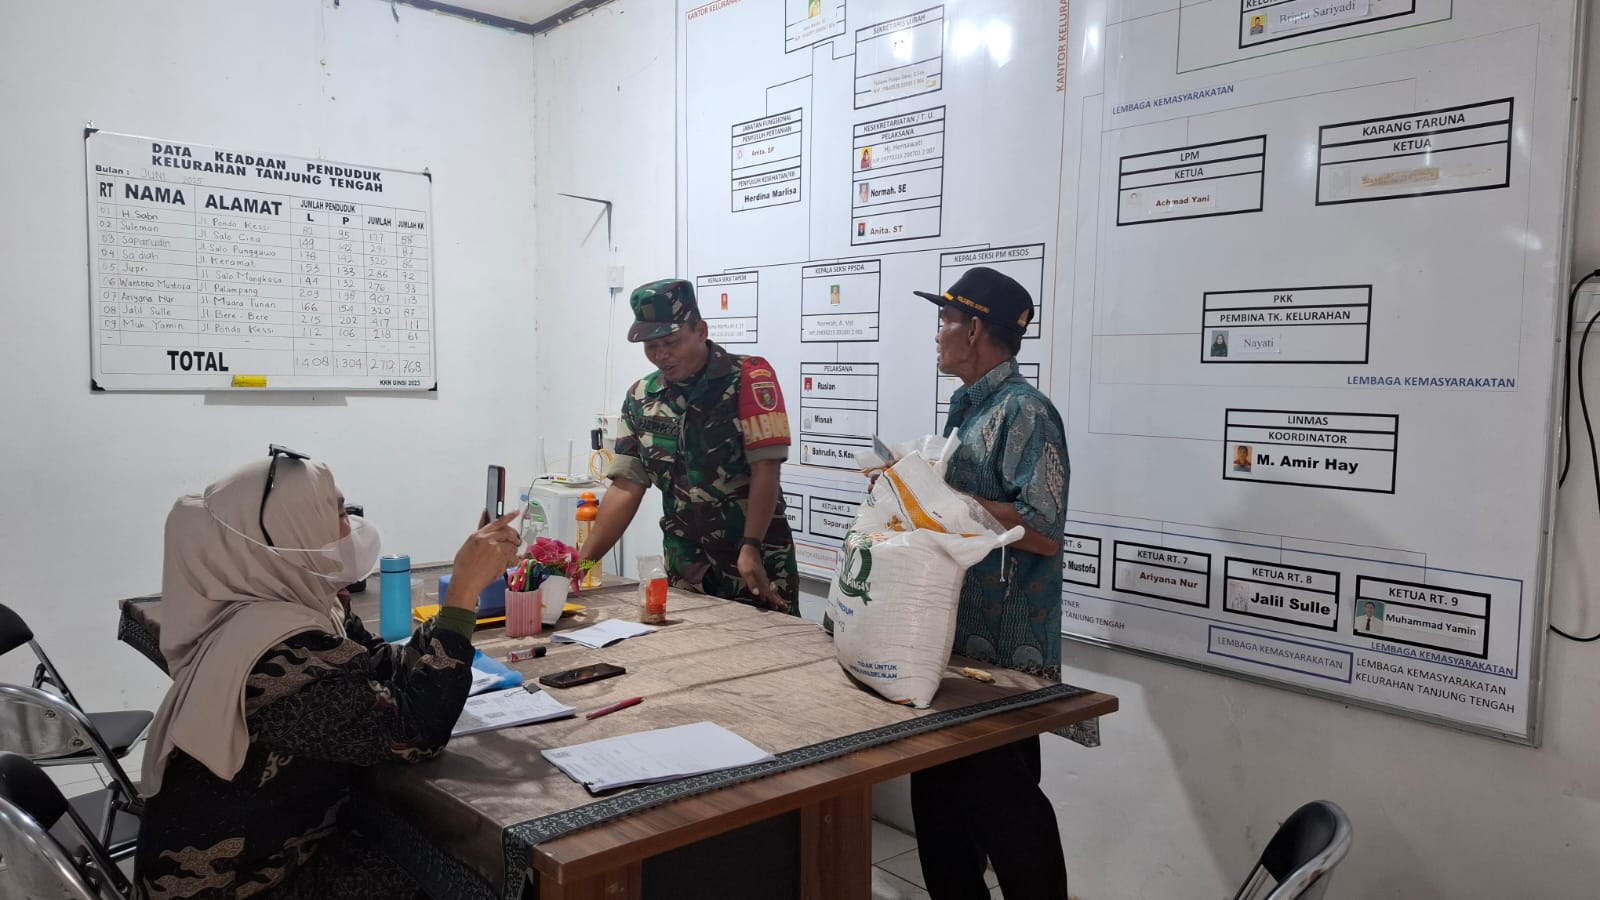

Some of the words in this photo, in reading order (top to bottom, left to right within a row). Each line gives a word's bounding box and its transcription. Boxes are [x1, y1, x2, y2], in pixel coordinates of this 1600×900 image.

[1056, 43, 1066, 92] KANTOR
[1112, 101, 1151, 115] LEMBAGA
[1153, 84, 1234, 107] KEMASYARAKATAN
[863, 115, 915, 132] KESEKRETARIATAN
[1362, 120, 1411, 137] KARANG
[1414, 113, 1465, 130] TARUNA
[881, 128, 914, 141] PELAKSANA
[1393, 138, 1432, 152] KETUA
[152, 142, 192, 158] DATA
[214, 151, 286, 170] KEADAAN
[306, 163, 381, 182] PENDUDUK
[1180, 150, 1200, 162] LPM
[96, 164, 124, 175] Bulan
[152, 155, 246, 176] KELURAHAN
[256, 168, 322, 185] TANJUNG
[330, 177, 383, 192] TENGAH
[1175, 168, 1204, 179] KETUA
[100, 182, 114, 198] RT
[125, 184, 186, 206] NAMA
[898, 184, 907, 193] SE
[744, 192, 770, 203] Herdina
[772, 188, 797, 198] Marlisa
[1156, 197, 1189, 207] Achmad
[1192, 195, 1210, 204] Yani
[205, 194, 282, 216] ALAMAT
[300, 200, 324, 210] JUMLAH
[325, 202, 356, 213] PENDUDUK
[307, 214, 314, 222] L
[342, 217, 350, 225] P
[368, 216, 392, 227] JUMLAH
[398, 221, 417, 230] JUMLAH
[893, 225, 903, 234] ST
[954, 254, 977, 263] KEPALA
[978, 252, 994, 261] SEKSI
[995, 251, 1007, 259] PM
[1008, 248, 1029, 258] KESOS
[337, 267, 356, 277] 133
[1273, 294, 1293, 304] PKK
[104, 306, 116, 314] 08
[122, 304, 142, 314] Jalil
[301, 303, 318, 312] 166
[371, 307, 391, 315] 320
[301, 315, 321, 324] 215
[1220, 312, 1265, 323] PEMBINA
[1267, 312, 1283, 322] TK.
[1286, 310, 1351, 321] KELURAHAN
[303, 328, 321, 336] 112
[340, 329, 355, 338] 106
[408, 332, 418, 341] 61
[1244, 337, 1274, 350] Nayati
[167, 350, 229, 372] TOTAL
[403, 360, 422, 374] 768
[1347, 376, 1402, 387] LEMBAGA
[1404, 377, 1515, 388] KEMASYARAKATAN
[1287, 416, 1328, 426] LINMAS
[1268, 432, 1348, 444] KOORDINATOR
[1256, 454, 1275, 466] M.
[1280, 456, 1320, 470] Amir
[1325, 458, 1359, 474] Hay
[1064, 540, 1075, 549] RT.
[1077, 541, 1082, 549] 6
[1137, 550, 1164, 562] KETUA
[1167, 554, 1180, 564] RT.
[1183, 557, 1188, 565] 7
[1068, 562, 1096, 575] Mustofa
[1140, 571, 1177, 587] Ariyana
[1179, 578, 1199, 590] Nur
[1252, 567, 1285, 581] KETUA
[1287, 572, 1303, 584] RT.
[1306, 575, 1312, 584] 8
[1389, 587, 1426, 602] KETUA
[1430, 593, 1448, 606] RT.
[1452, 596, 1458, 606] 9
[1251, 592, 1284, 608] Jalil
[1289, 598, 1331, 616] Sulle
[1065, 611, 1095, 624] TANJUNG
[1096, 616, 1126, 630] TENGAH
[1385, 613, 1443, 631] Muhammad
[1445, 622, 1477, 636] Yamin
[1217, 637, 1258, 651] LEMBAGA
[1260, 645, 1344, 670] KEMASYARAKATAN
[1371, 641, 1418, 658] LEMBAGA
[1419, 649, 1514, 676] KEMASYARAKATAN
[1357, 658, 1404, 674] LEMBAGA
[1407, 665, 1507, 695] KEMASYARAKATAN
[1355, 672, 1415, 692] KELURAHAN
[1417, 682, 1466, 703] TANJUNG
[1470, 695, 1514, 713] TENGAH
